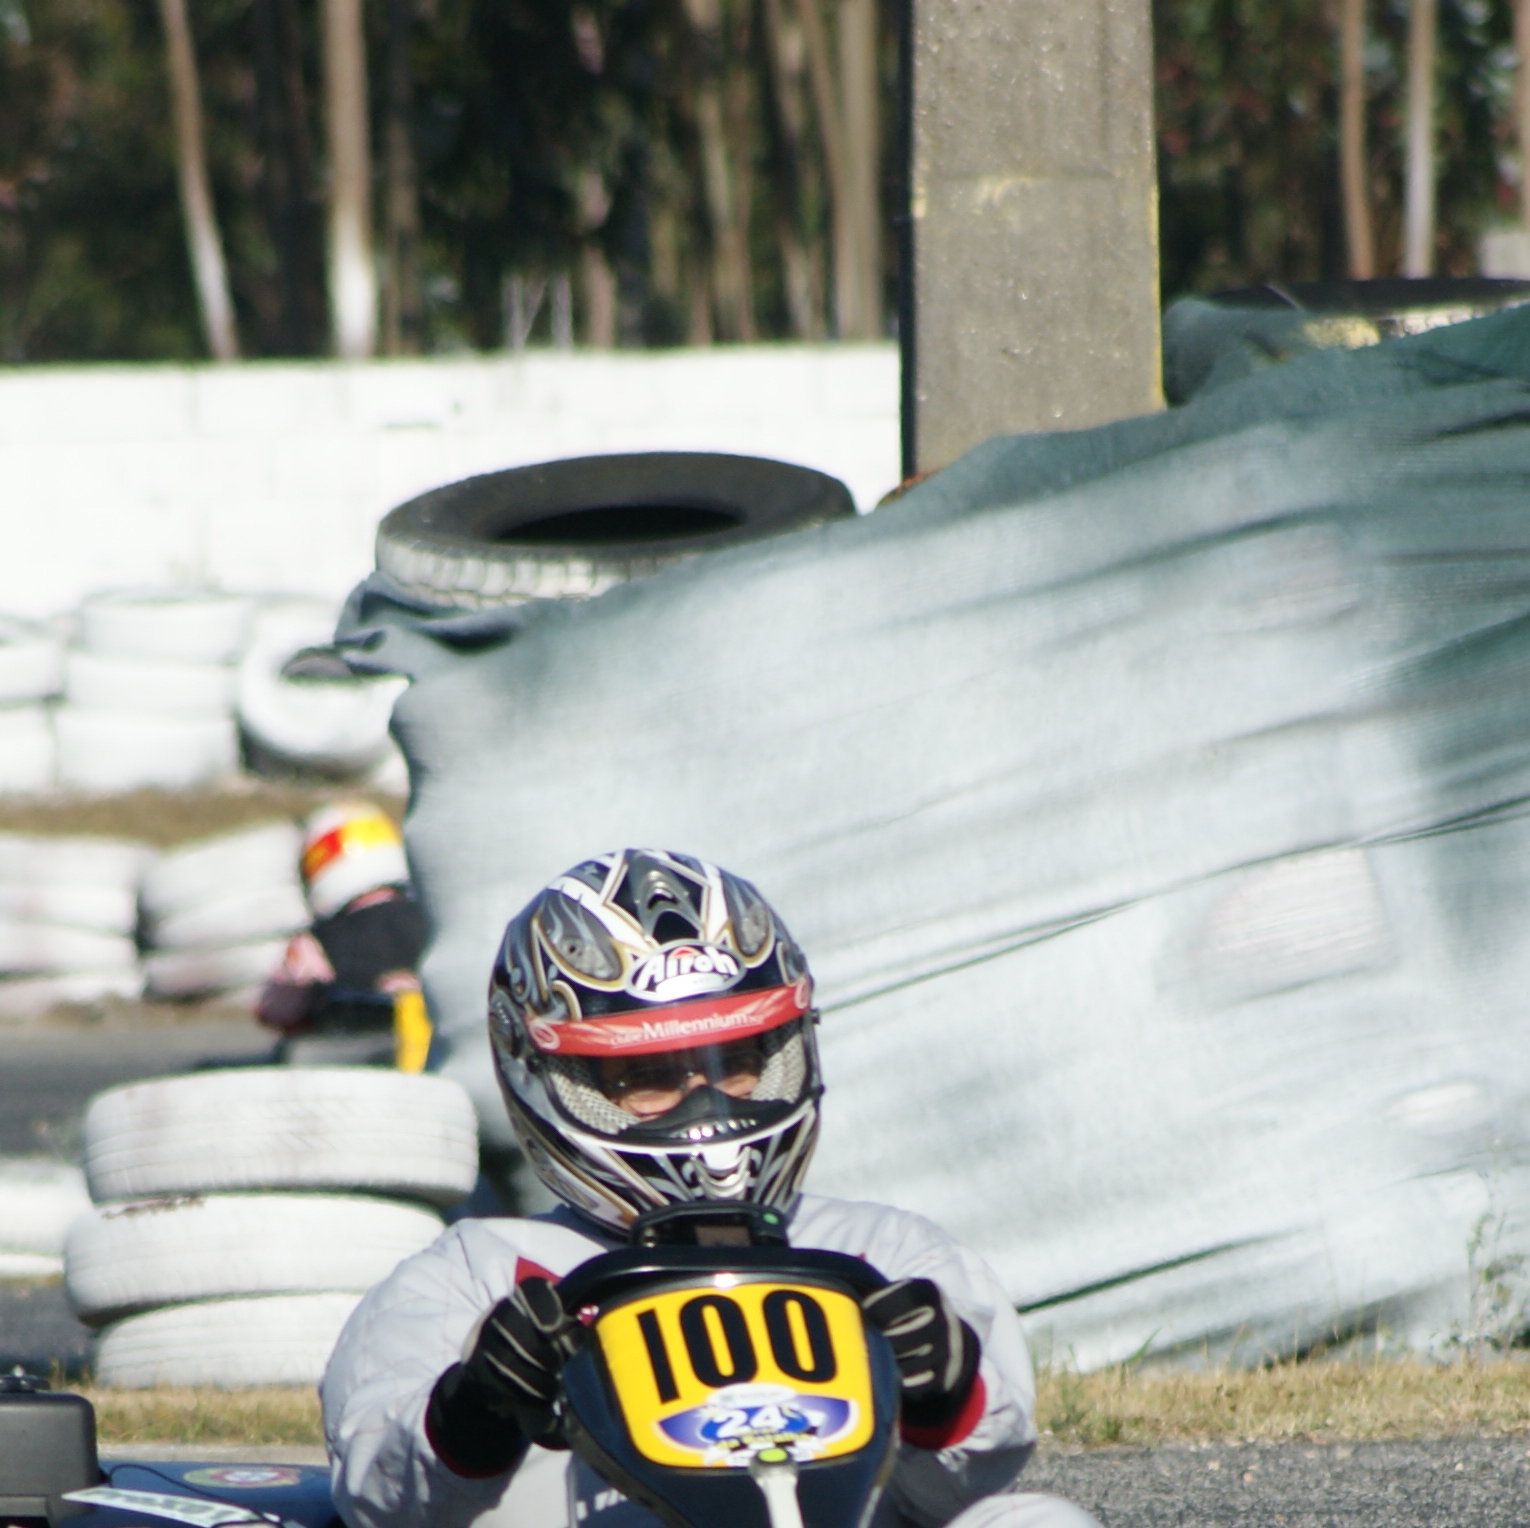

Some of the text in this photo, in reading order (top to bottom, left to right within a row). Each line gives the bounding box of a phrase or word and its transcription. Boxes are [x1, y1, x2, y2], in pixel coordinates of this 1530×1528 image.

[635, 945, 740, 991] Airoh
[641, 1012, 748, 1041] Millennium
[637, 1290, 837, 1405] 100
[713, 1406, 789, 1438] 24
